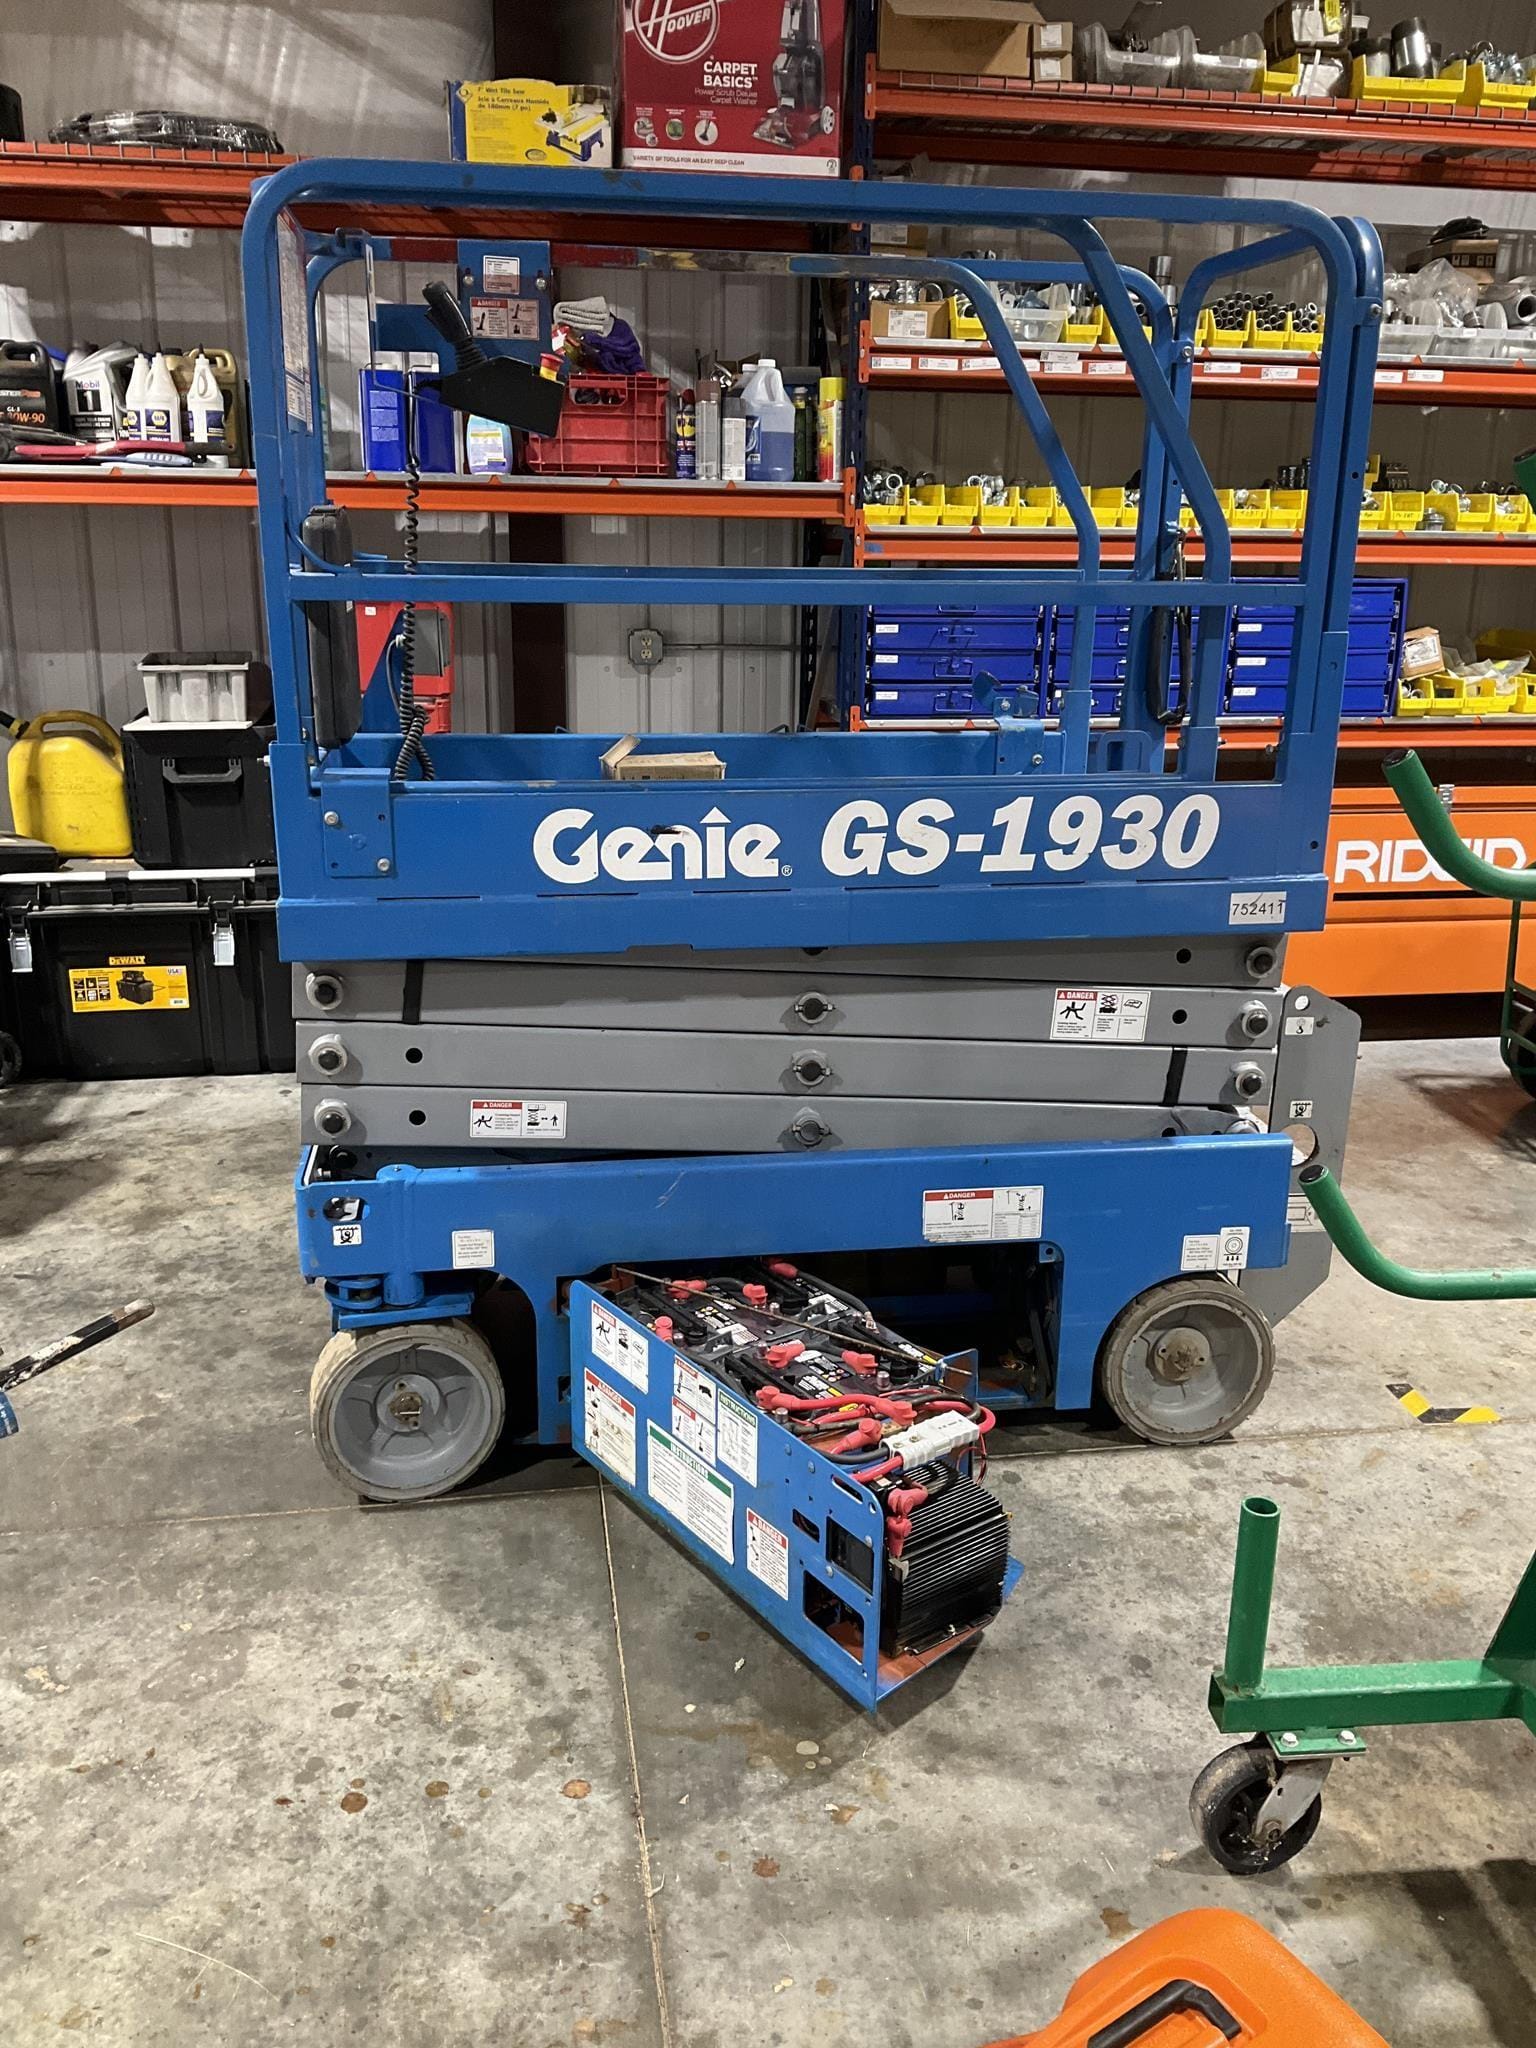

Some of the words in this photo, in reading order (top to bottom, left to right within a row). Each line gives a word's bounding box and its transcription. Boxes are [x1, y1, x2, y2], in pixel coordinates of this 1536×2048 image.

[703, 61, 758, 75] CARPET
[703, 75, 753, 88] BASICS
[694, 87, 715, 95] Power
[716, 88, 735, 96] Scrub
[710, 96, 732, 105] Carpet
[734, 97, 757, 105] Washer
[76, 381, 100, 389] Mobil
[83, 391, 94, 411] 1
[532, 806, 782, 884] Genie
[821, 794, 1220, 876] GS-1930
[1231, 901, 1286, 916] 752411
[1066, 991, 1094, 999] DANGER
[720, 1392, 756, 1427] INSTRUCTIONS
[758, 1519, 783, 1545] DANGER
